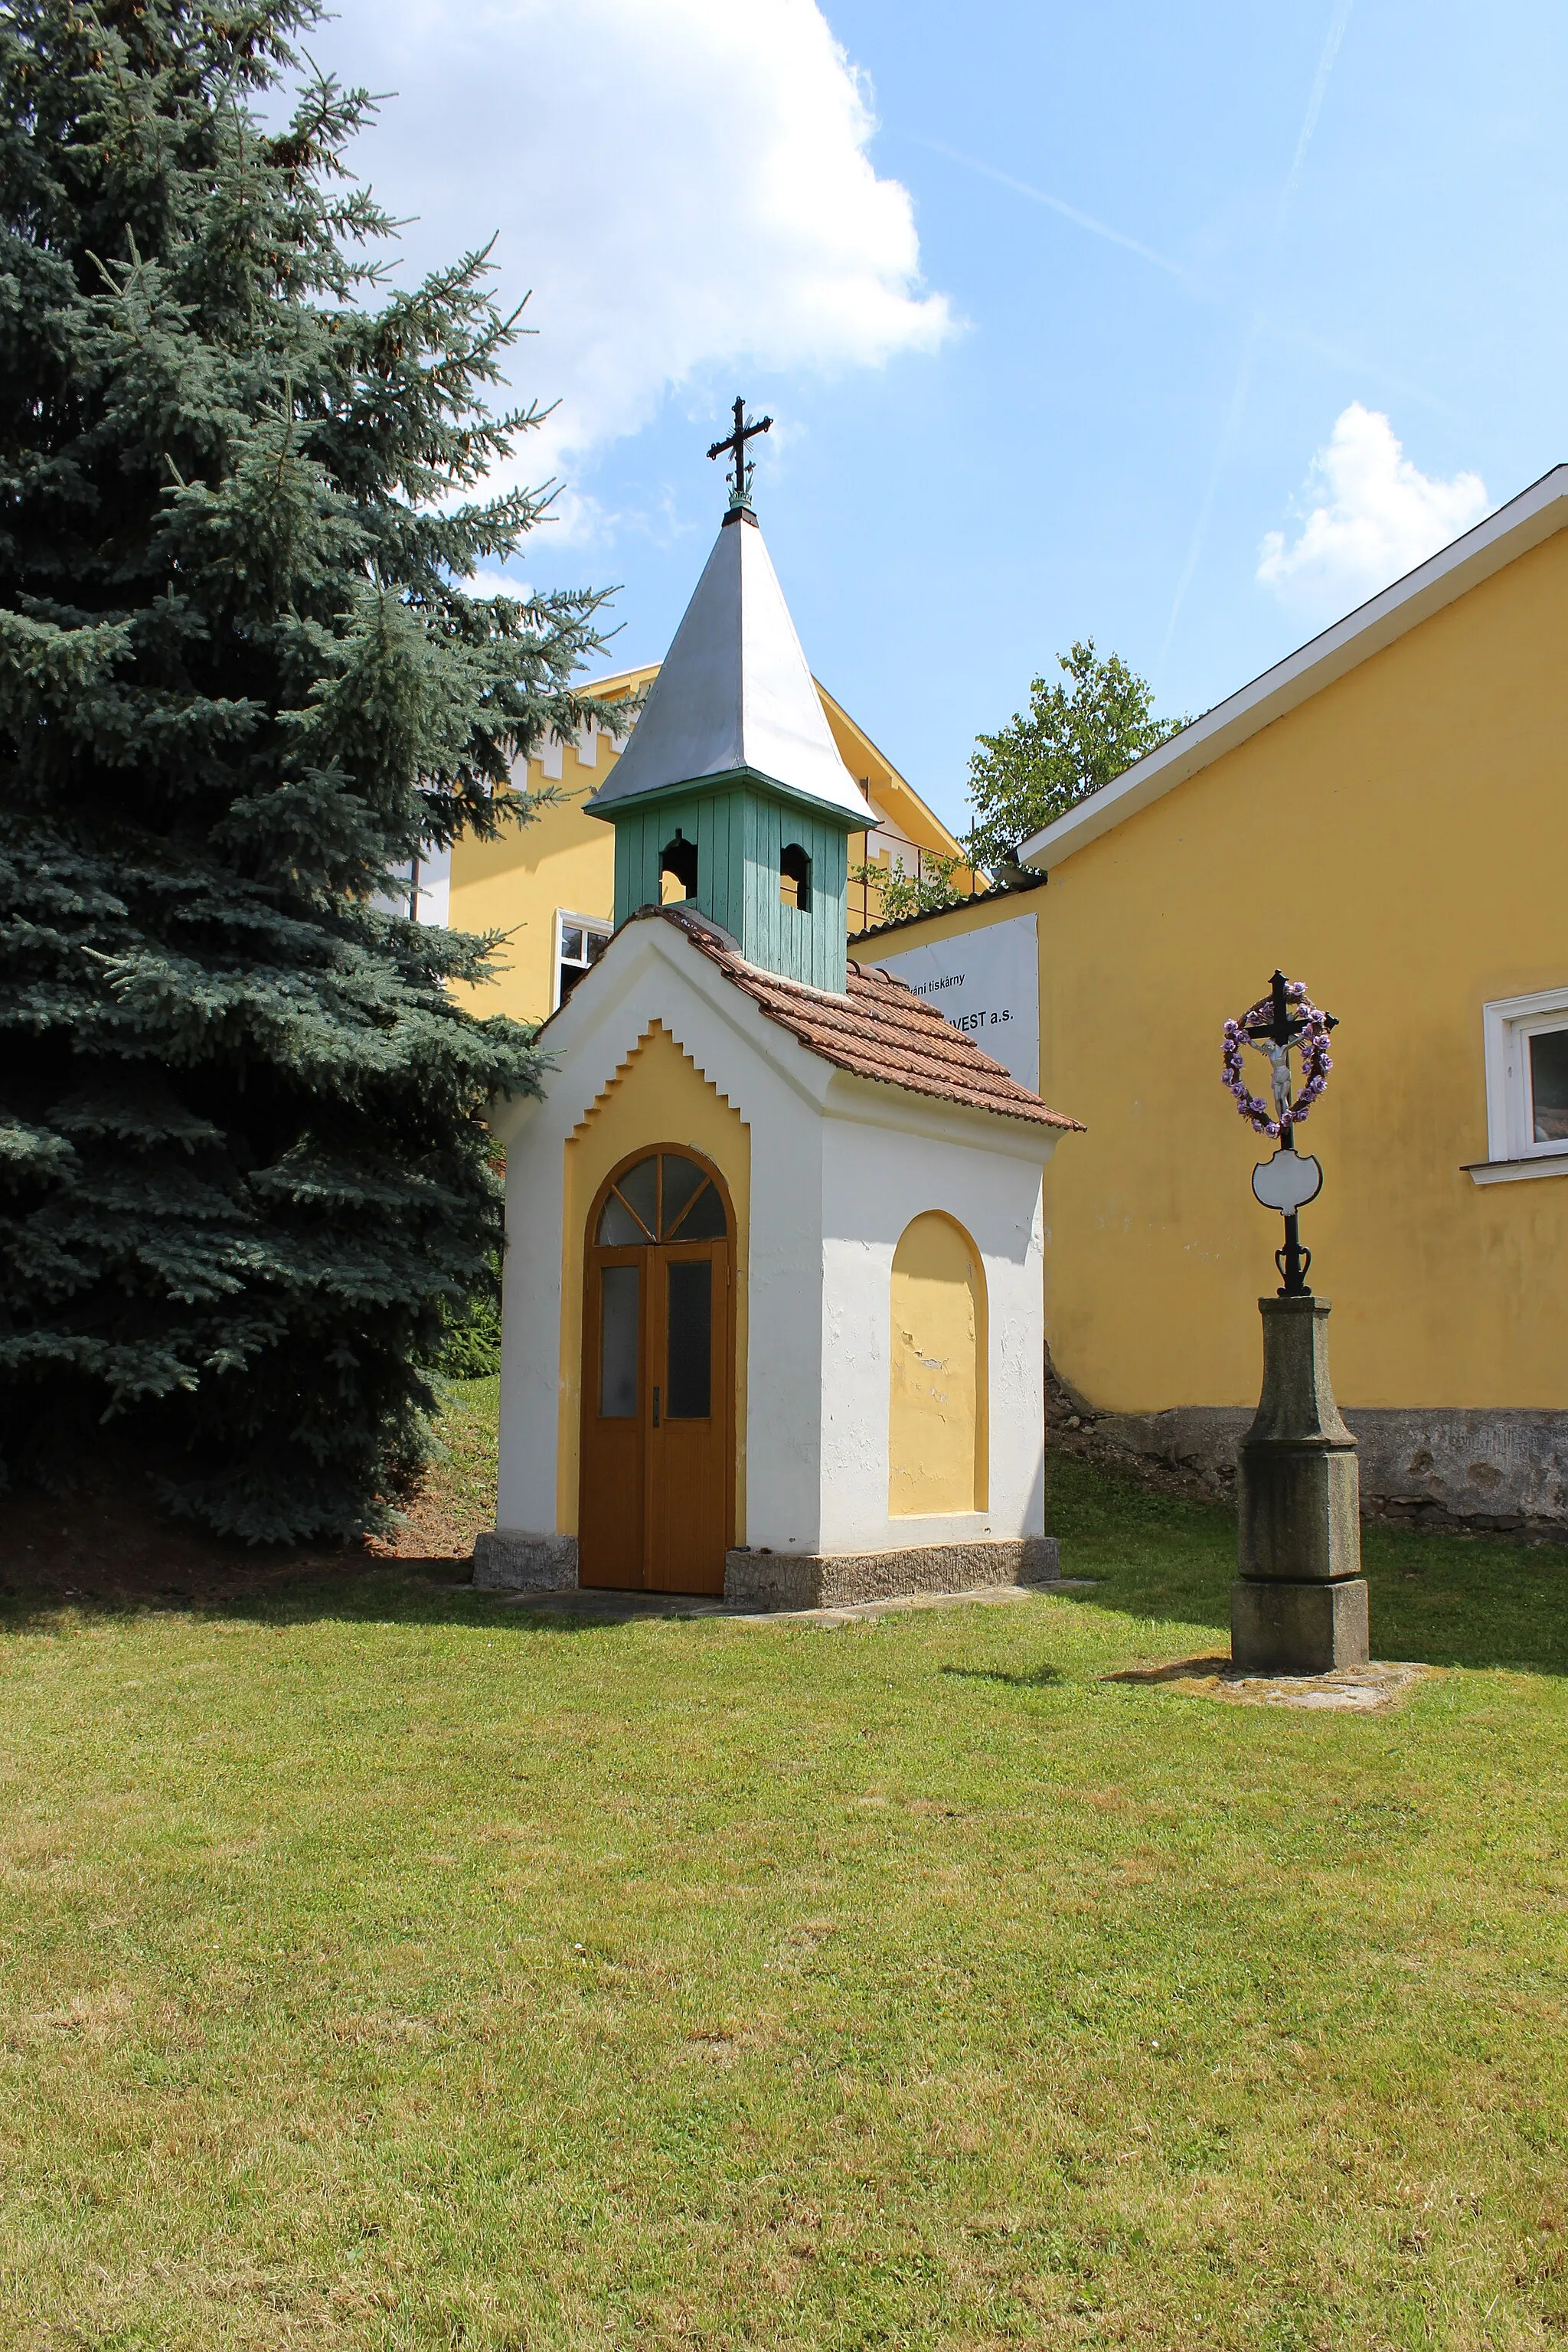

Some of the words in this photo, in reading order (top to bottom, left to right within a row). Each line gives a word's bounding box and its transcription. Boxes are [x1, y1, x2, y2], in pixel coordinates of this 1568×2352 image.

[929, 974, 965, 992] tiskárny
[949, 1011, 986, 1031] VEST
[990, 1009, 1014, 1024] a.s.
